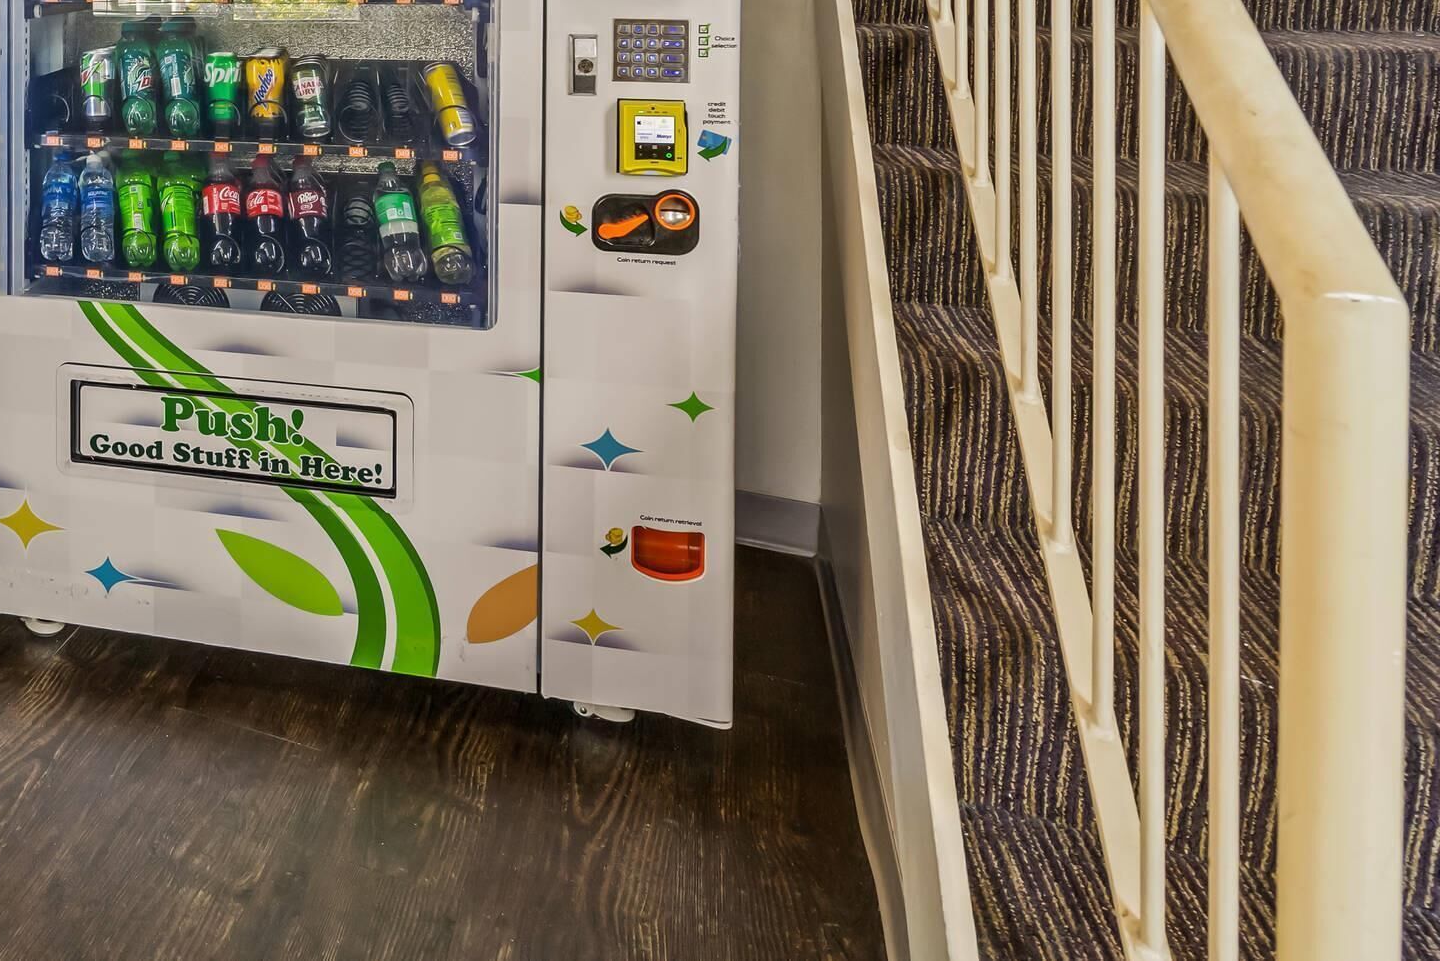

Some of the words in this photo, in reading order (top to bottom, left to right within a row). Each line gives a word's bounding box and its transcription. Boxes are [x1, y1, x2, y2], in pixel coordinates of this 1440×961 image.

[160, 396, 305, 446] Push!
[89, 434, 164, 461] Good
[172, 443, 250, 470] Stuff
[259, 451, 291, 475] in
[300, 454, 384, 485] Here!
[675, 519, 703, 527] retrieval
